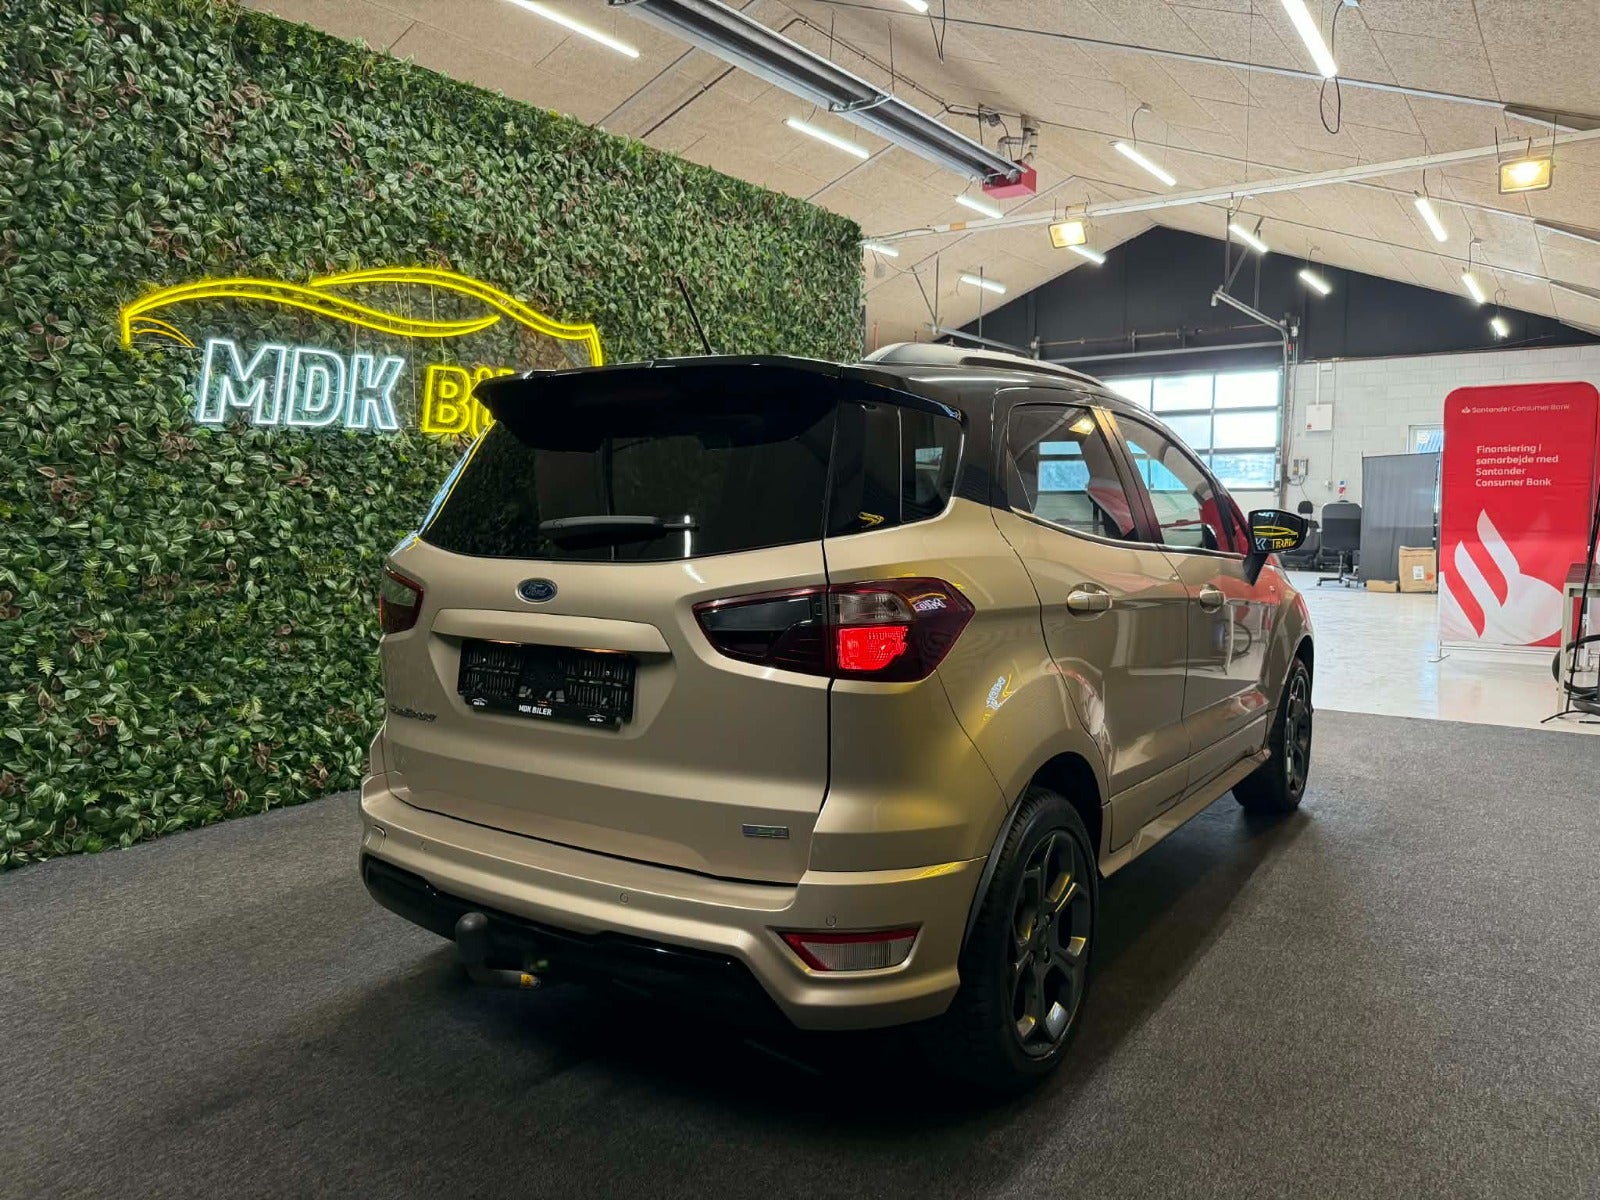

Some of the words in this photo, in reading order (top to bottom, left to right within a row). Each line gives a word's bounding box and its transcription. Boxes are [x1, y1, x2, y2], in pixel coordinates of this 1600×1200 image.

[198, 338, 405, 431] MDK
[1471, 406, 1511, 414] Santander
[1512, 404, 1549, 412] Consumer
[1550, 403, 1570, 411] Bank
[1476, 444, 1537, 454] Finansiering
[1475, 455, 1535, 466] samarbejde
[1536, 454, 1559, 464] med
[1475, 466, 1527, 476] Santander
[1475, 478, 1525, 488] Consumer
[1526, 477, 1552, 487] Bank
[532, 705, 552, 716] BILER
